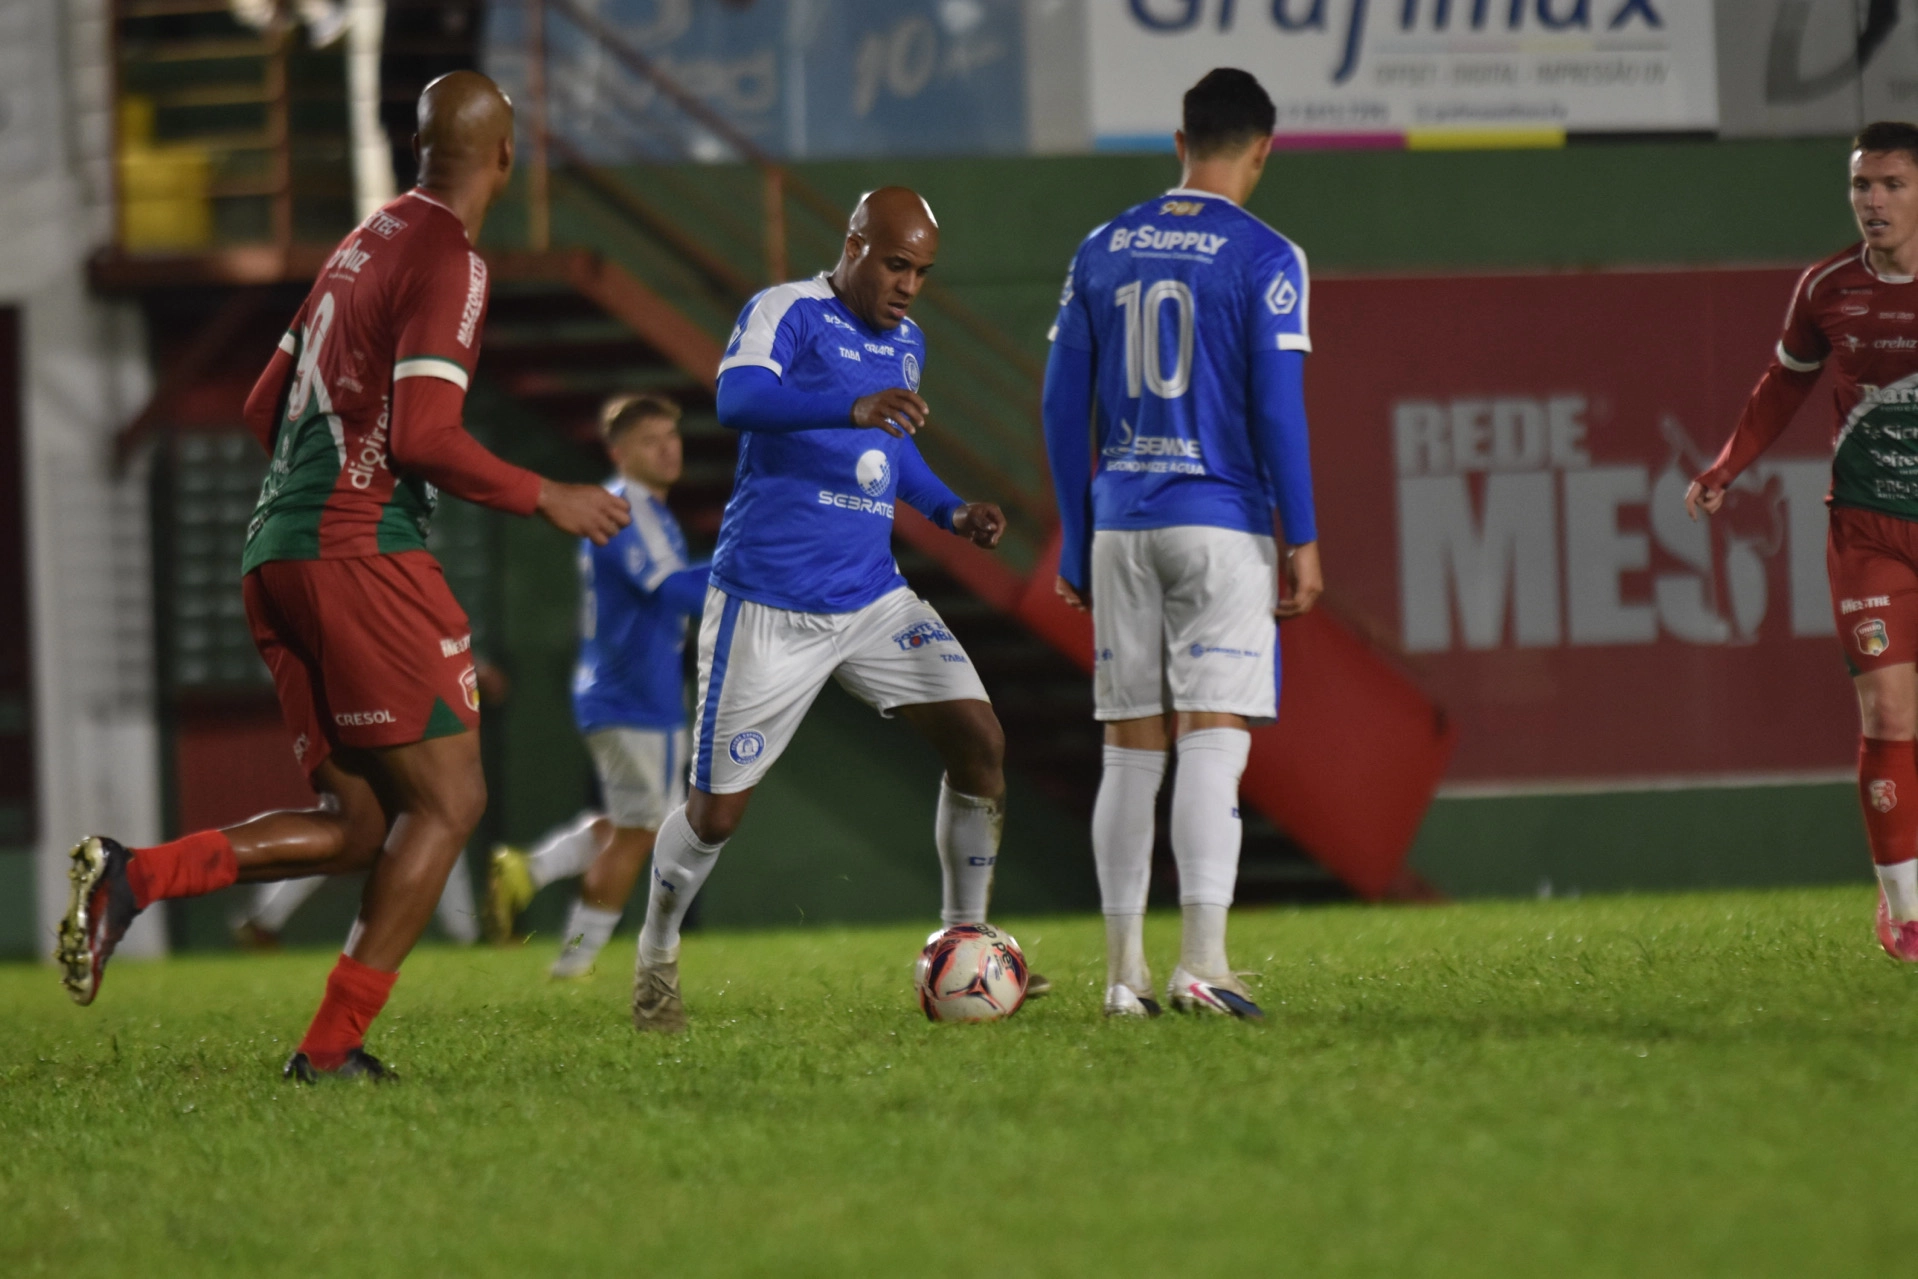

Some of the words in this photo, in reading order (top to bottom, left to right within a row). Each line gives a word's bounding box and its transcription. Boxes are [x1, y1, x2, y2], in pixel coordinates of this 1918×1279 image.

[1115, 280, 1194, 399] 10
[1393, 396, 1589, 473] REDE
[336, 710, 396, 726] CRESOL
